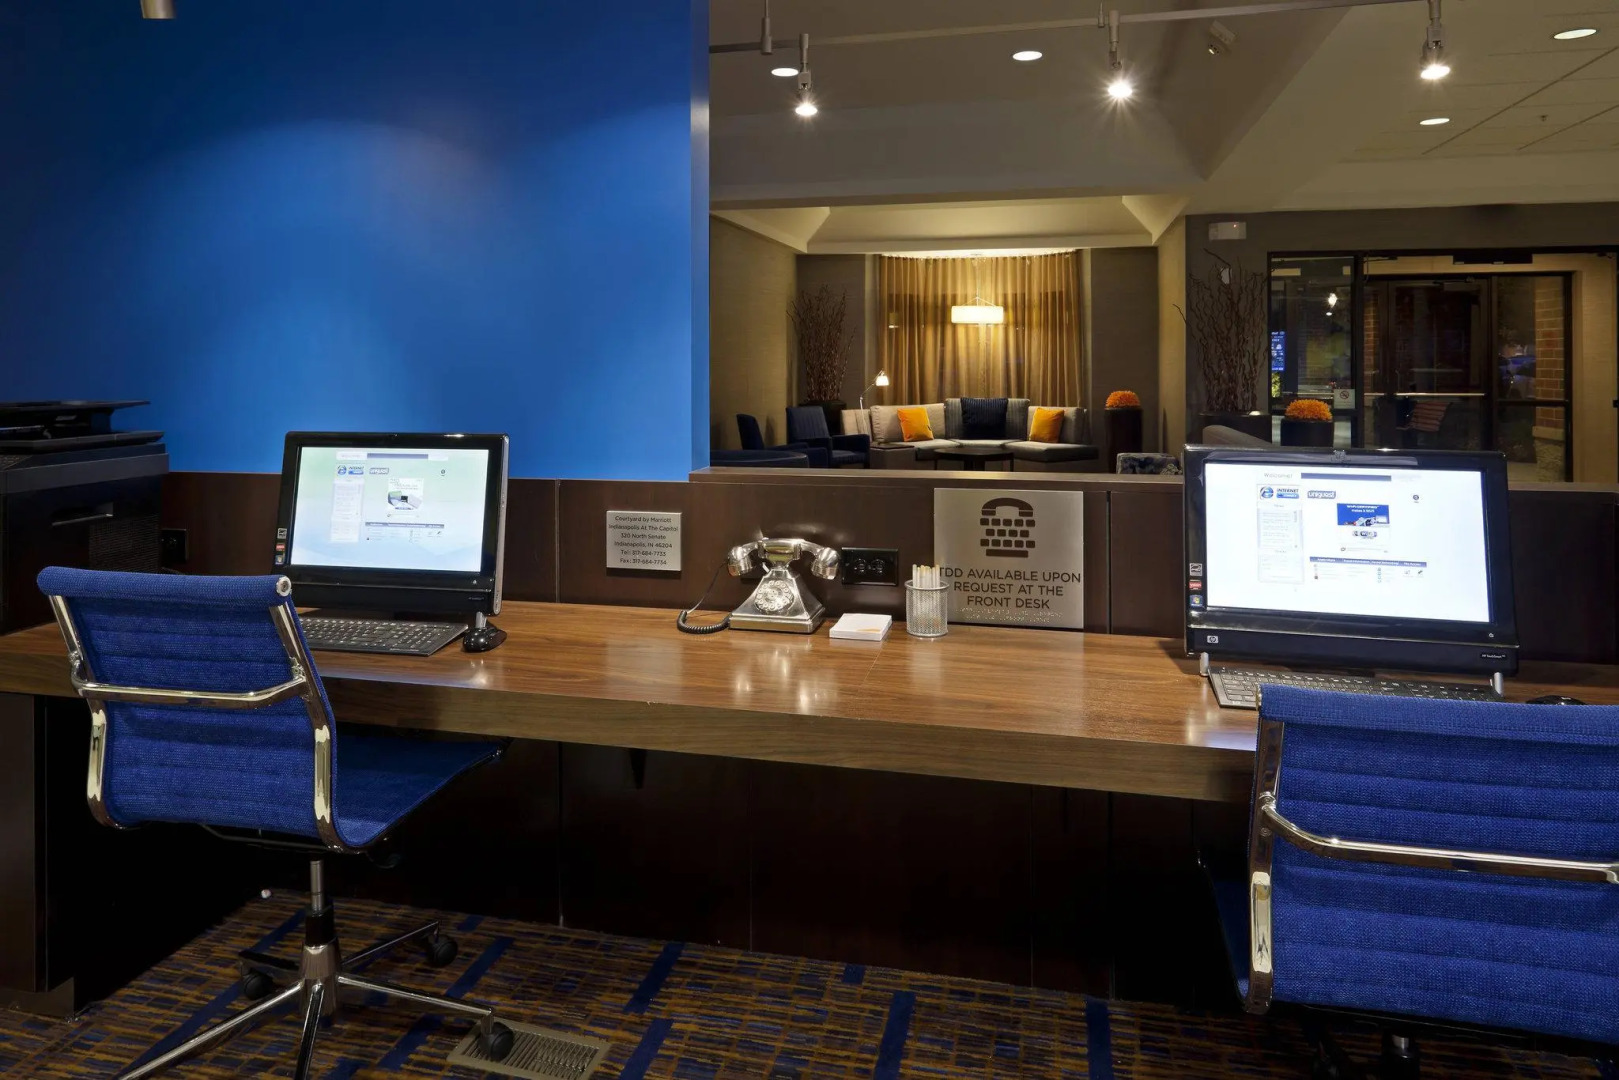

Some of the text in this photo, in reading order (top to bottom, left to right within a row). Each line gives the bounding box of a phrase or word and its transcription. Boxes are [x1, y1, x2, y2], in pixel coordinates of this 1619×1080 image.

[940, 567, 1081, 583] TDD AVAILABLE UPON
[954, 582, 1064, 596] REQUEST AT THE
[967, 596, 1050, 610] FRONT DESK
